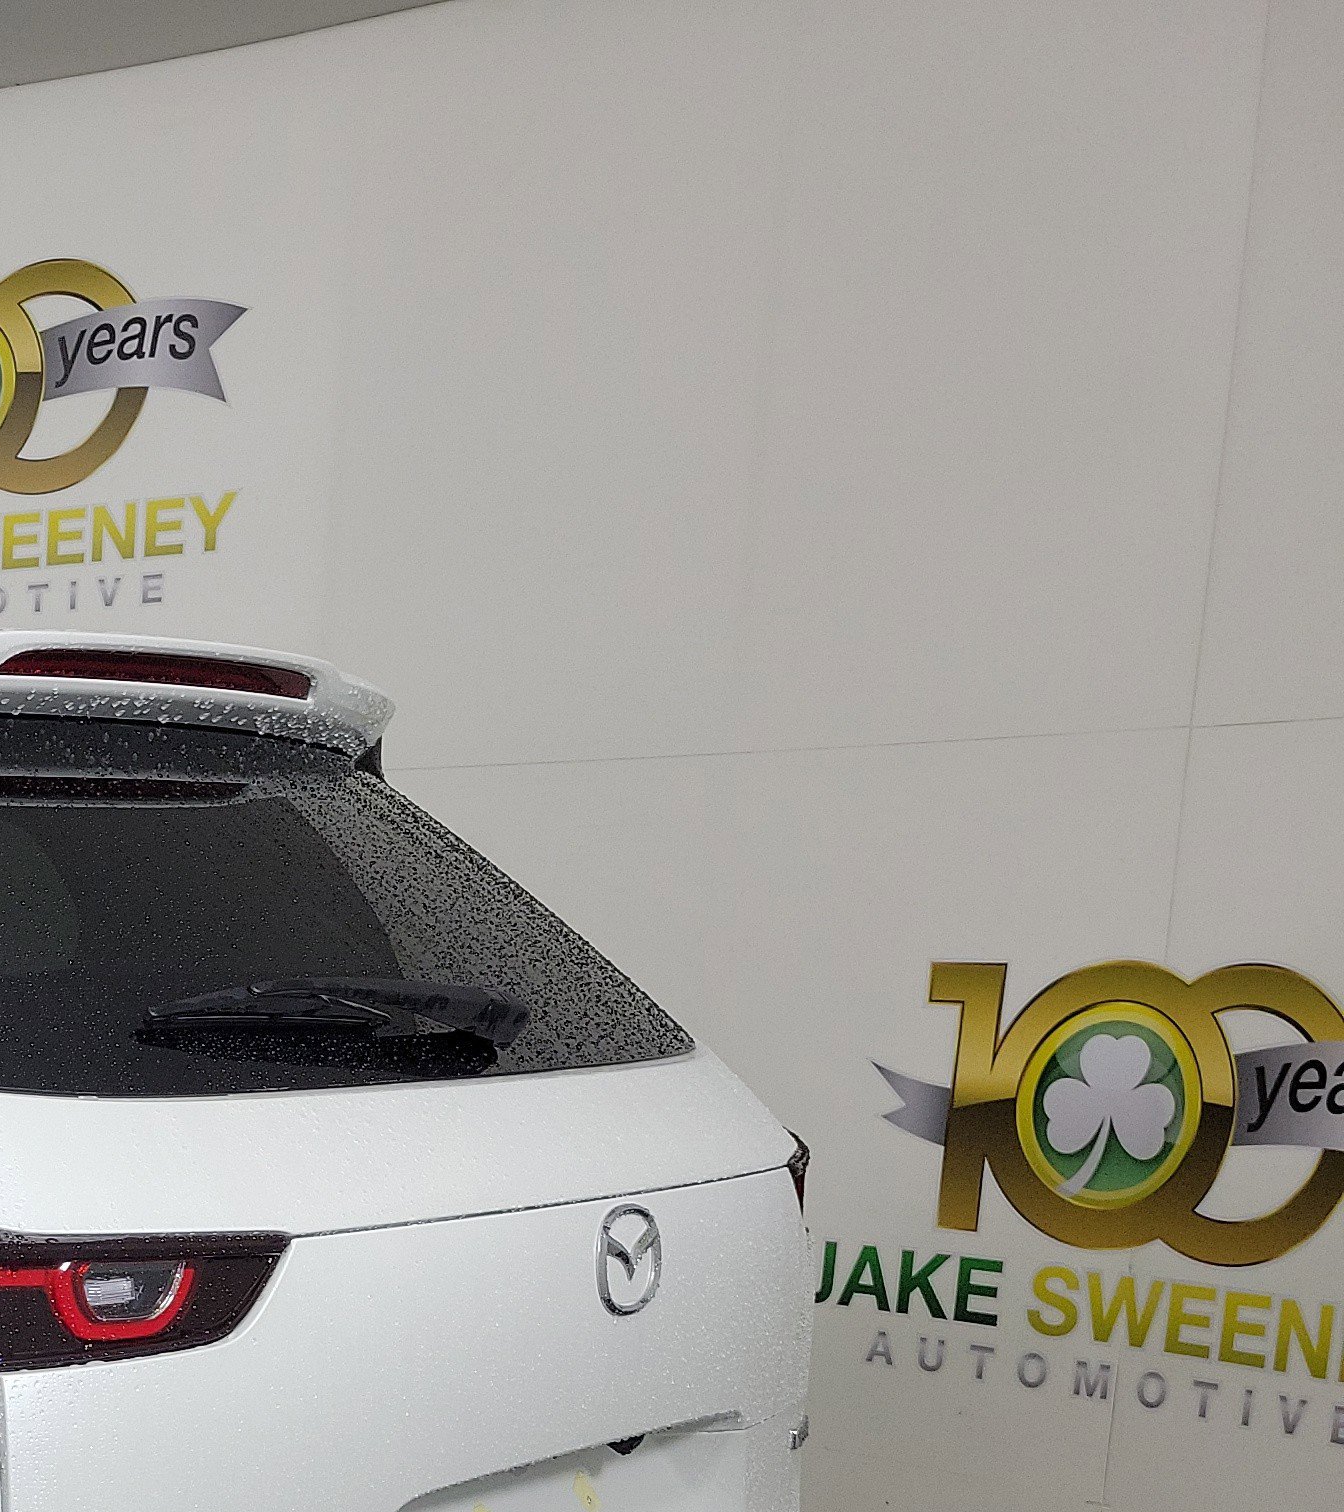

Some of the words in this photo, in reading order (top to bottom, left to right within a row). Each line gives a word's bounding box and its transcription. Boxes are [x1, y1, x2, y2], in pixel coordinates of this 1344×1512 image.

[54, 312, 199, 388] years
[814, 1241, 1003, 1327] JAKE
[1026, 1266, 1344, 1382] SWEEN
